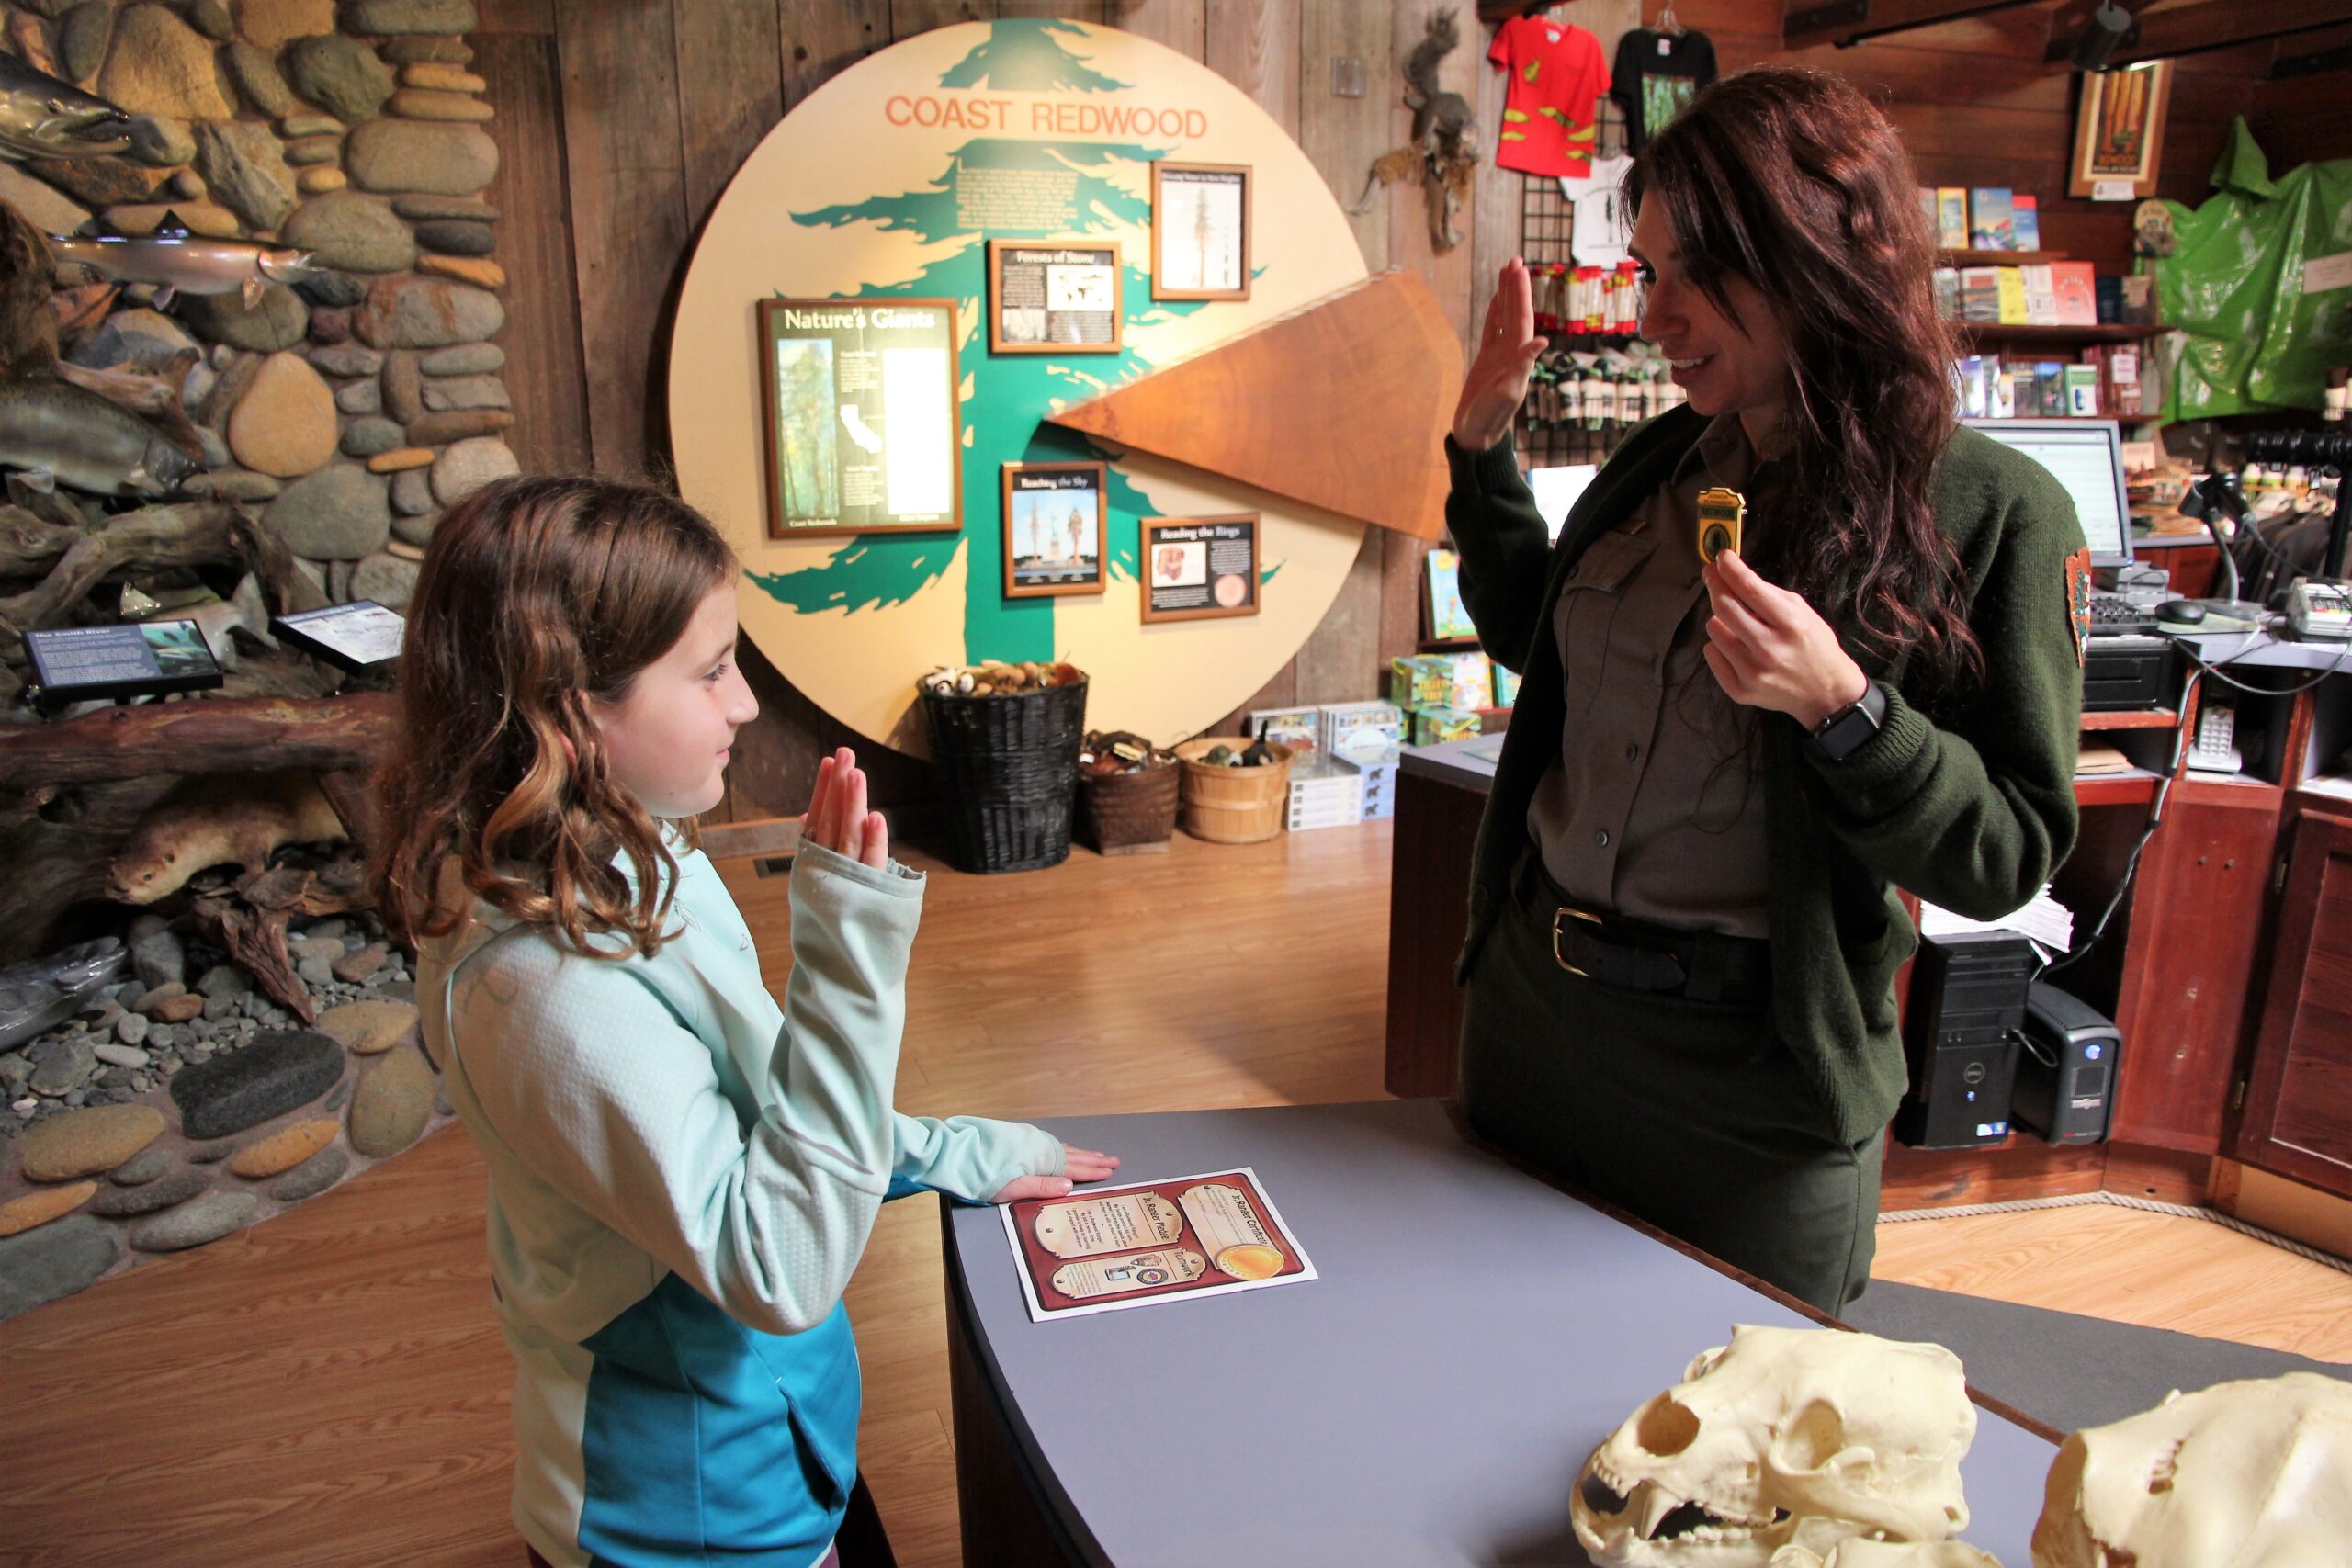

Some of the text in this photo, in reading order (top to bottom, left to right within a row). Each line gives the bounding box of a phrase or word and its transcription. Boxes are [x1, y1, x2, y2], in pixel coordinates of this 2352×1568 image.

[886, 96, 1208, 139] COAST REDWOOD
[1016, 250, 1096, 265] Forests of Stone
[785, 307, 935, 330] Nature's Giants
[1021, 476, 1088, 490] Reaching the Sky
[1161, 525, 1240, 541] Reading the Rings
[55, 629, 85, 638] Smith
[85, 627, 111, 636] River
[1146, 1203, 1159, 1221] Ranger
[1155, 1222, 1169, 1239] Pledge
[1236, 1201, 1251, 1218] Ranger
[1246, 1219, 1267, 1246] Certificate
[1174, 1250, 1194, 1277] Teamwork
